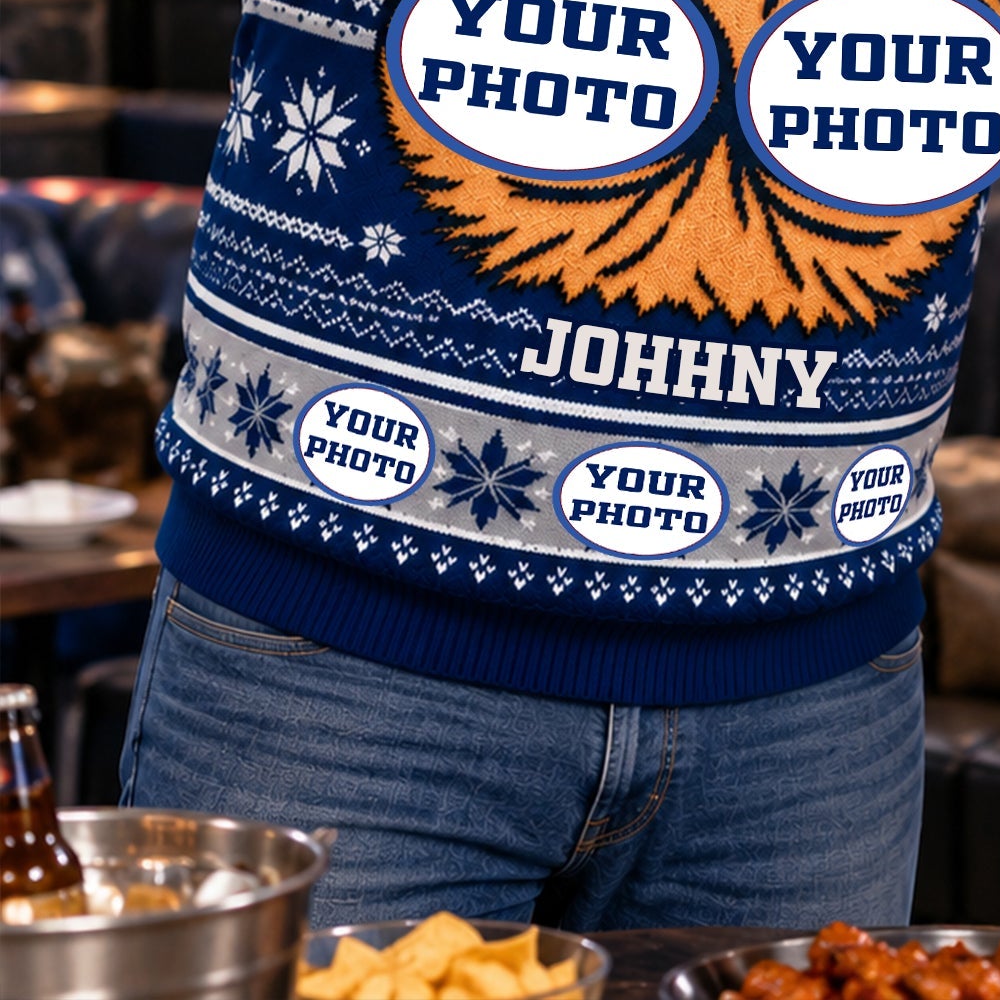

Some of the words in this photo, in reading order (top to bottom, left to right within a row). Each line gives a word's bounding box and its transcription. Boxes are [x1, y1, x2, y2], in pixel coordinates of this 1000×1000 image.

[783, 30, 993, 86] YOUR
[417, 57, 677, 130] PHOTO
[520, 317, 838, 409] JOHHNY
[324, 399, 419, 451] YOUR
[303, 434, 417, 485] PHOTO
[585, 462, 706, 501] YOUR
[850, 463, 905, 492] YOUR
[568, 498, 709, 534] PHOTO
[837, 493, 903, 524] PHOTO
